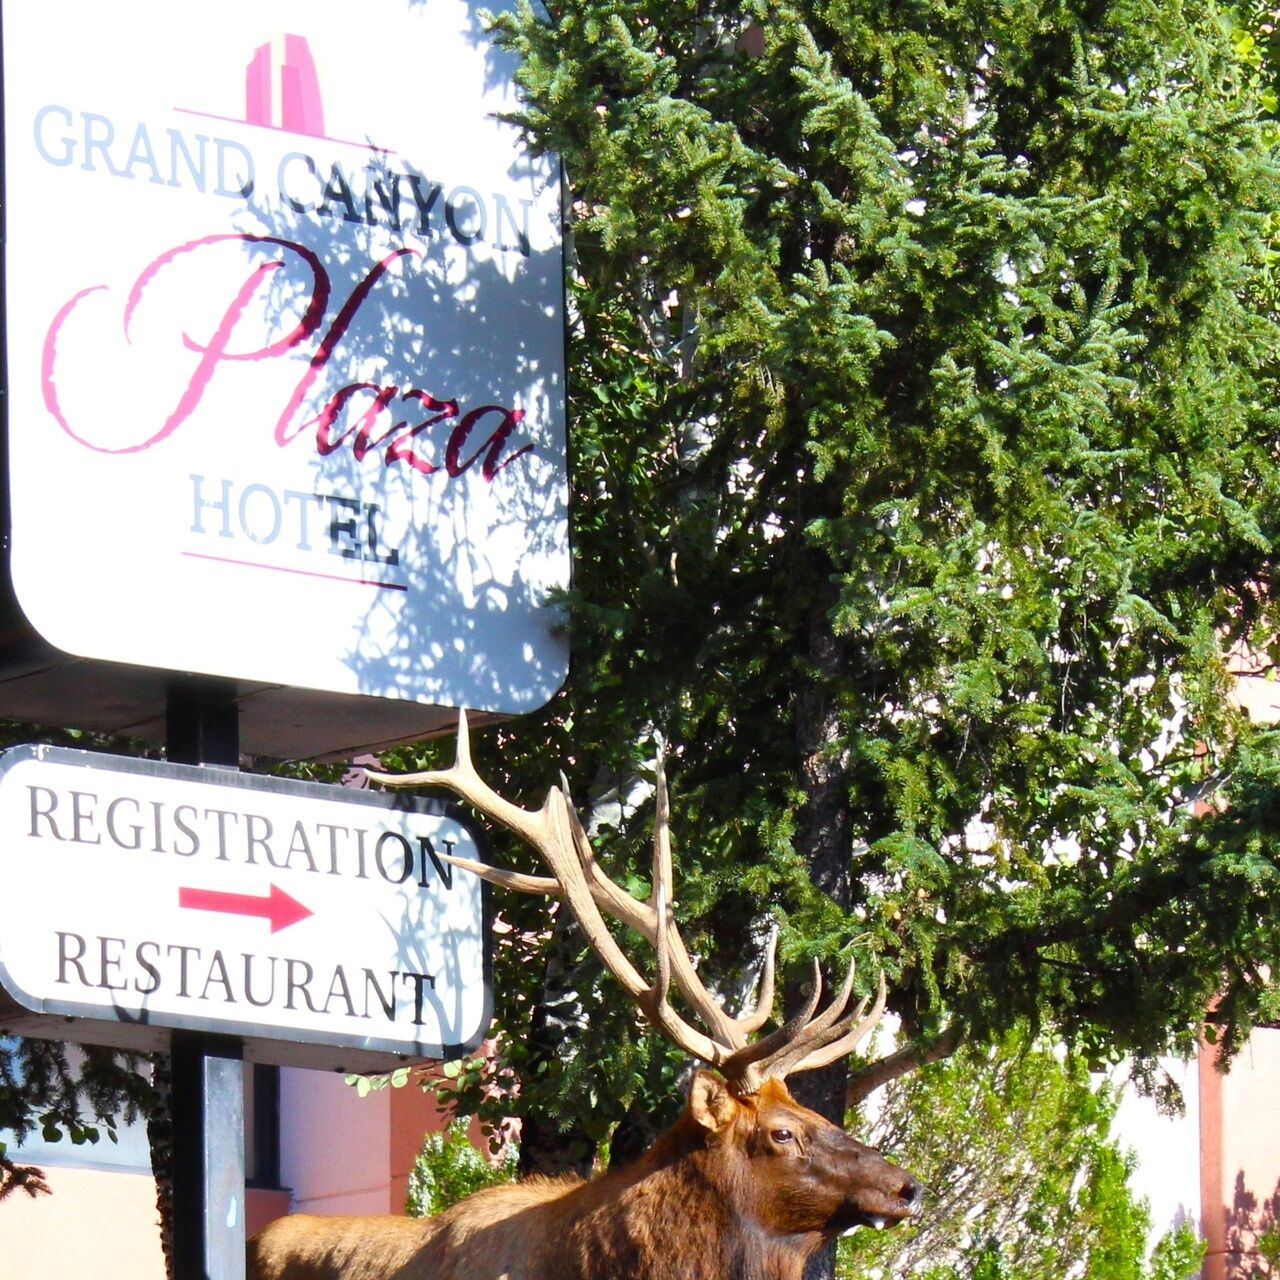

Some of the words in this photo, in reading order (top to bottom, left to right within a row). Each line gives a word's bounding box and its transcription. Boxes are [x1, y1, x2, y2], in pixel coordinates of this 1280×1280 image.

[33, 104, 256, 199] GRAND
[277, 152, 534, 258] CANYON
[41, 233, 535, 484] Plaza
[188, 473, 399, 566] HOTEL
[26, 784, 456, 891] REGISTRATION
[54, 931, 436, 1026] RESTAURANT
